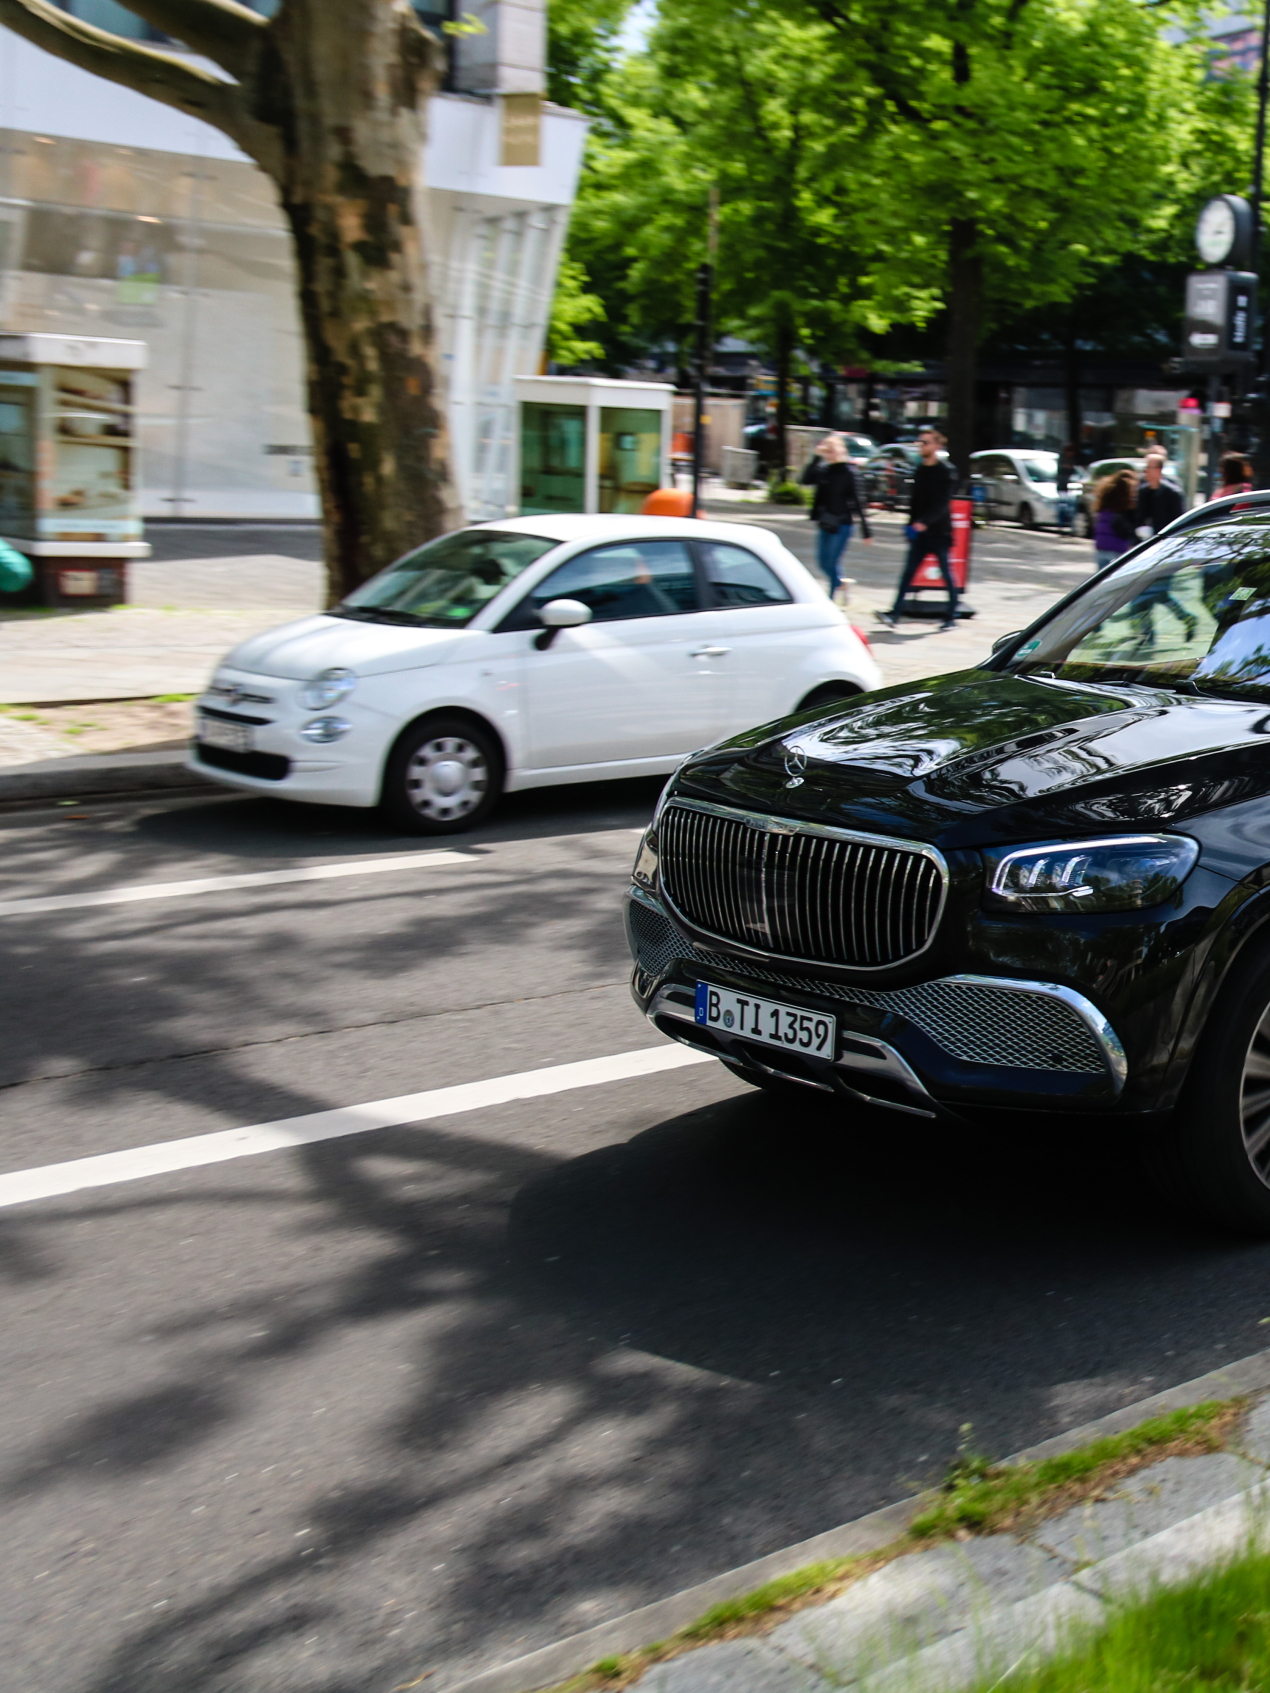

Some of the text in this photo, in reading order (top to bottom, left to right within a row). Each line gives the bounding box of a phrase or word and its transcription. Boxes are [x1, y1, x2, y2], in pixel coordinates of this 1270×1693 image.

[708, 989, 829, 1052] B TI 1359
